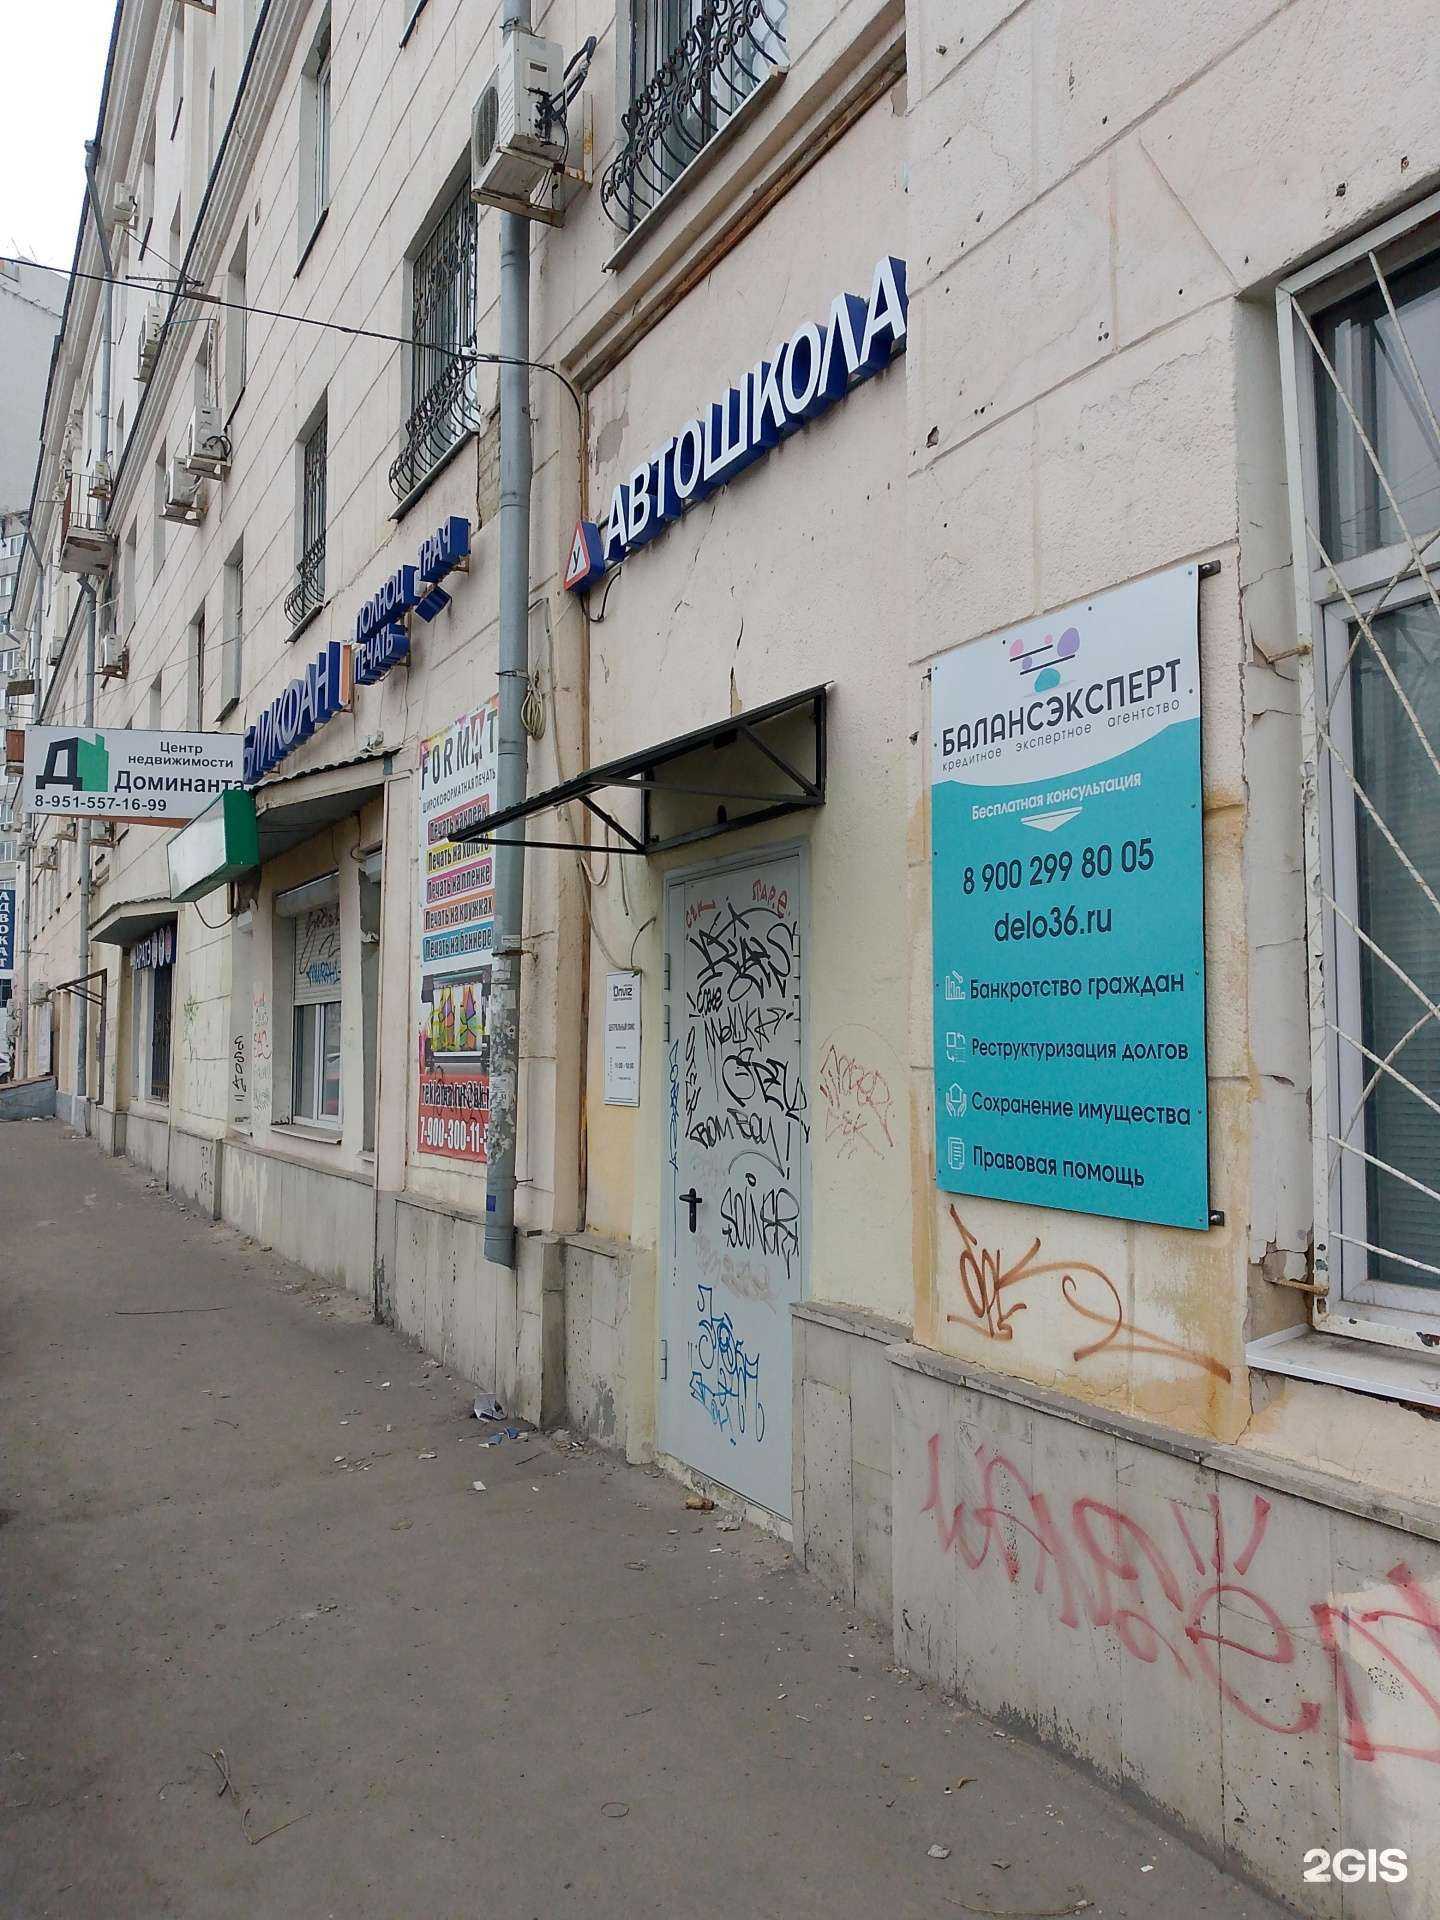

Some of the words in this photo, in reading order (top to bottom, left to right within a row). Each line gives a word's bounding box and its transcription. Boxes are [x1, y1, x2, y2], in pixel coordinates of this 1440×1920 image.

[604, 254, 908, 561] АВТОШКОЛА
[353, 622, 396, 685] ПЕЧАТЬ
[942, 658, 1181, 757] БАЛАНСЭКСПЕРТ
[160, 741, 203, 754] Центр
[420, 708, 498, 791] FORMAT
[942, 747, 1002, 772] кредитное
[1015, 723, 1092, 752] экспертное
[1107, 699, 1180, 728] агентство
[128, 754, 234, 768] недвижимости
[475, 767, 496, 787] ПЕЧАТЬ
[114, 770, 244, 794] Доминанта
[971, 793, 1045, 820] Бесплатная
[1046, 771, 1142, 806] консультация
[35, 795, 167, 811] 8-951-557-16-99
[428, 847, 452, 873] Печать
[963, 867, 975, 895] 8
[982, 859, 1022, 892] 900
[1029, 850, 1073, 887] 299
[1081, 844, 1112, 879] 80
[1121, 838, 1155, 873] 05
[427, 875, 451, 902] Печать
[461, 864, 490, 889] пленке
[0, 890, 10, 968] АДВОКАТ
[425, 908, 449, 931] Печать
[459, 896, 494, 922] кружках
[994, 905, 1112, 942] delo36.ru
[425, 936, 449, 960] Печать
[460, 927, 492, 952] баннере
[970, 978, 1082, 1002] Банкротство
[1088, 972, 1185, 1000] граждан
[972, 1038, 1117, 1061] Реструктуризация
[1121, 1042, 1189, 1061] долгов
[972, 1091, 1074, 1117] Сохранение
[1079, 1101, 1191, 1126] имущества
[973, 1145, 1057, 1175] Правовая
[1063, 1160, 1145, 1188] помощь
